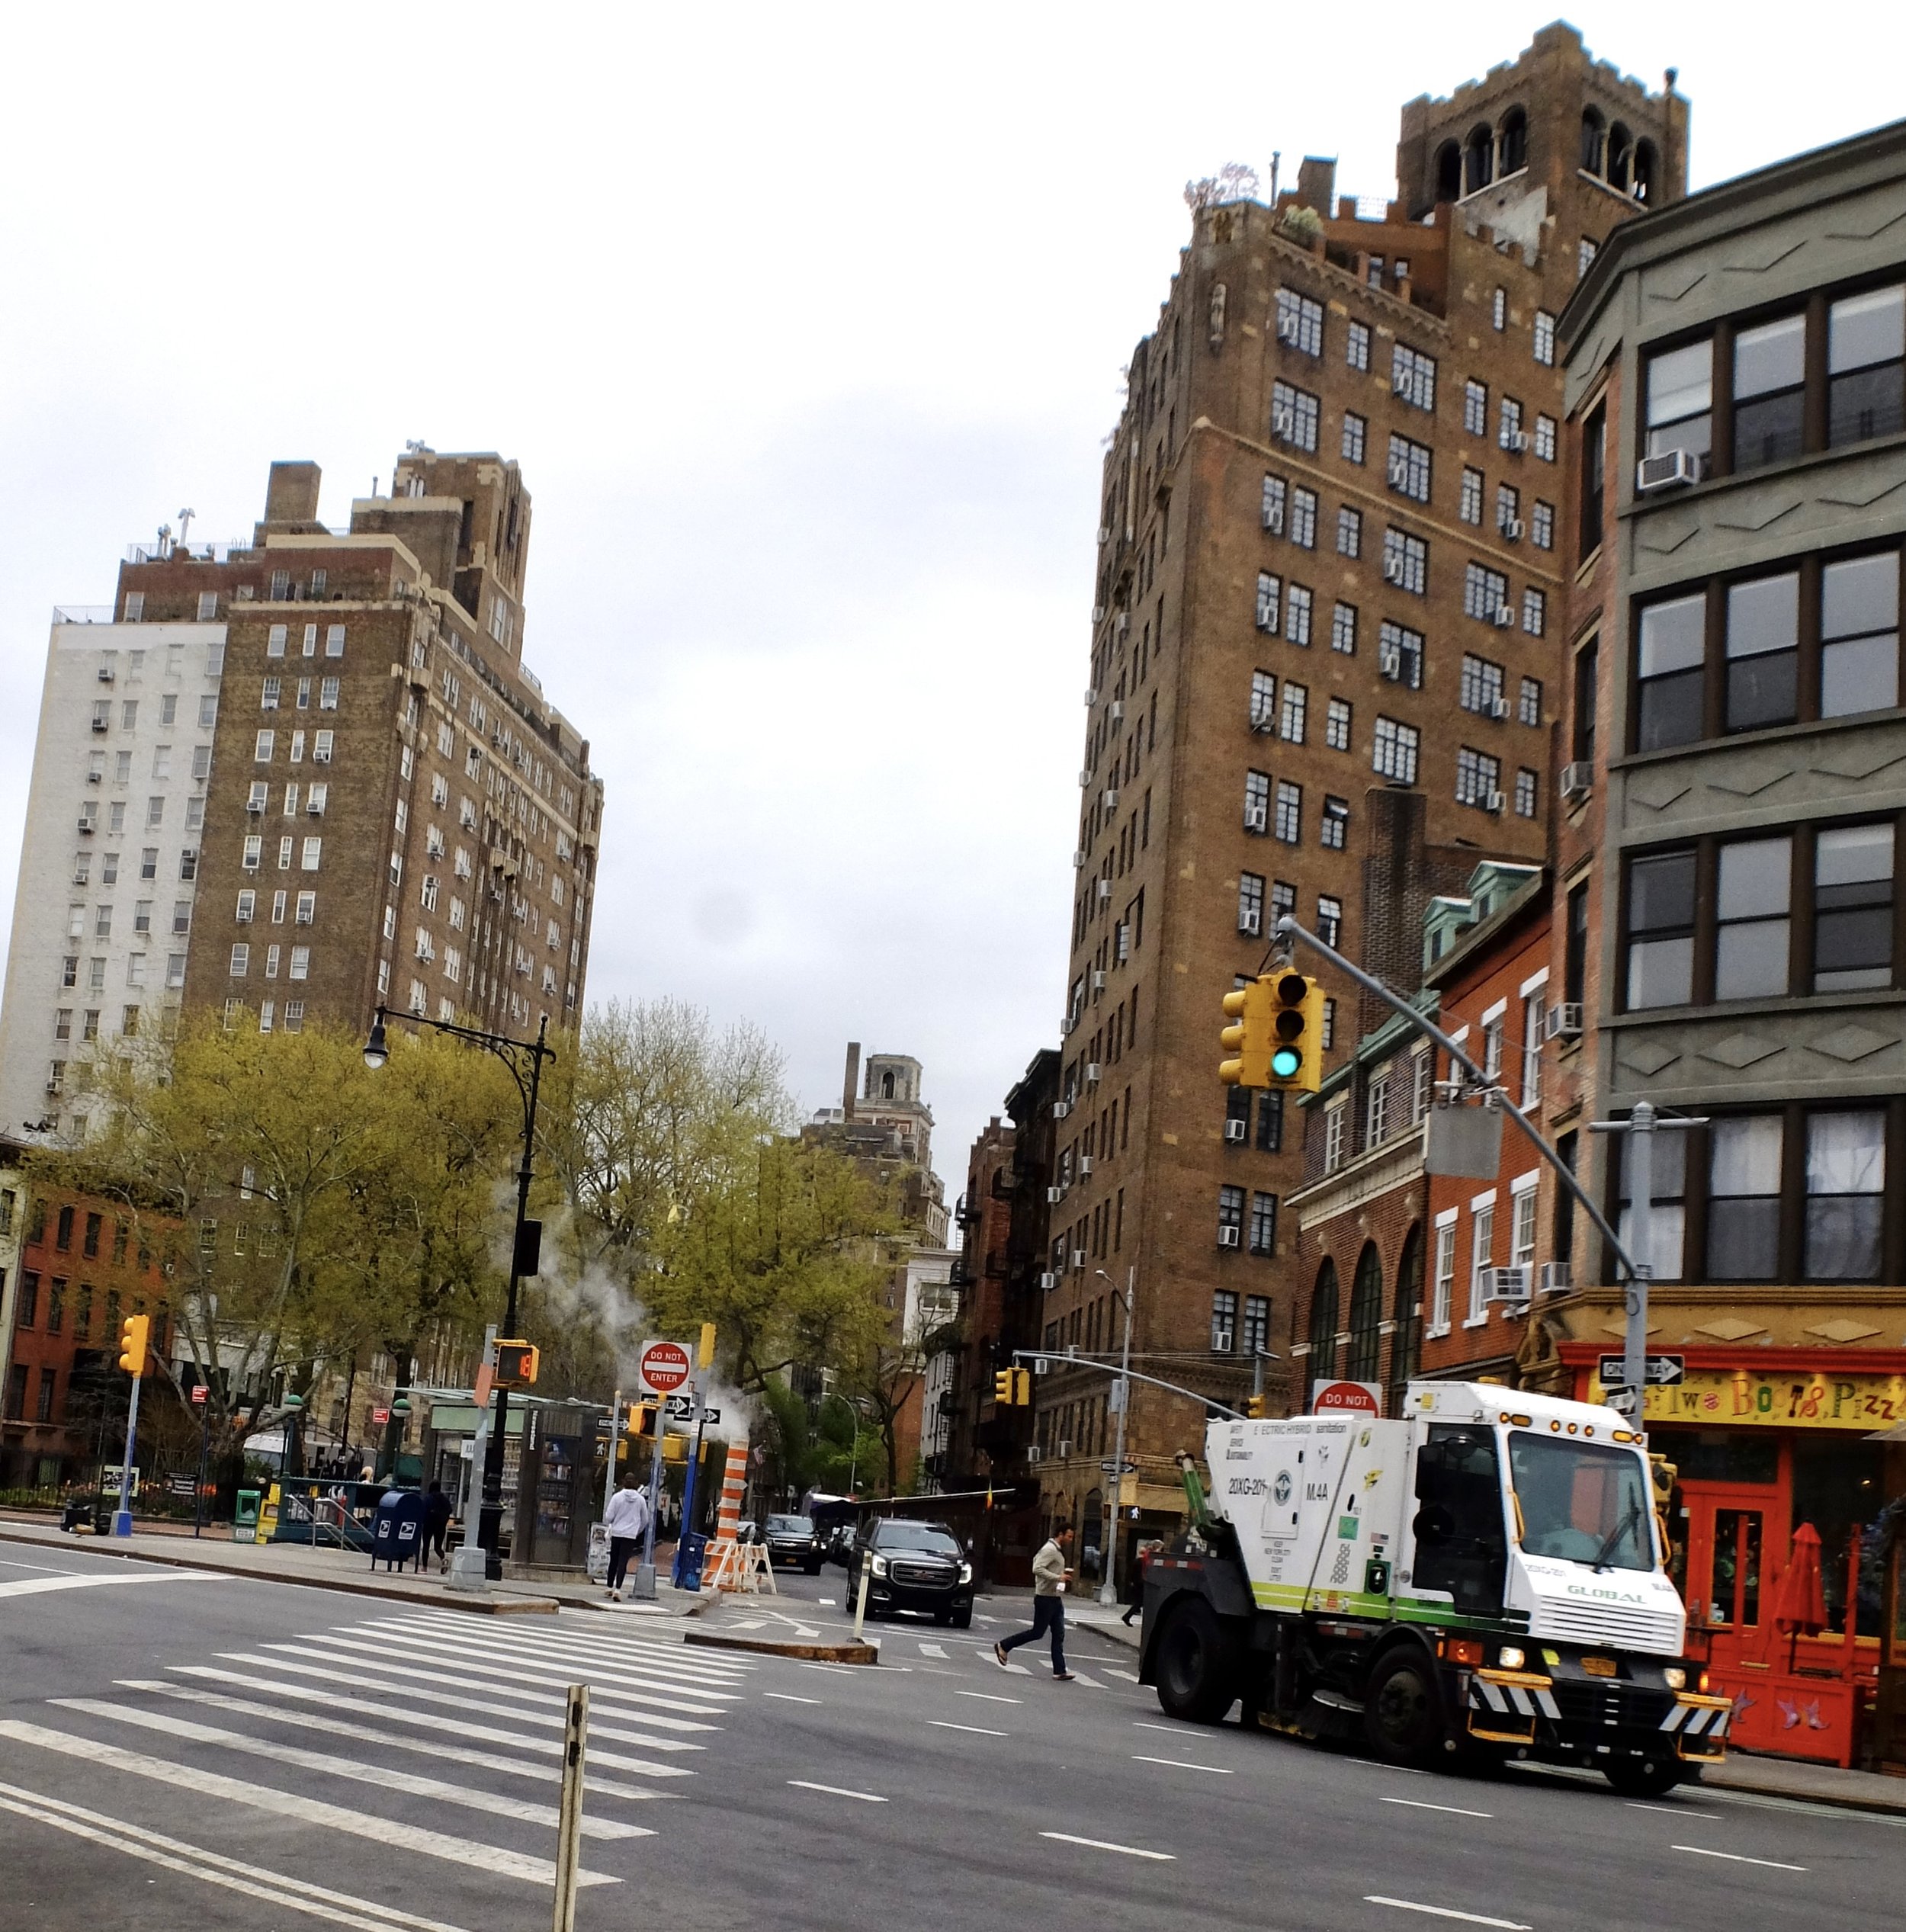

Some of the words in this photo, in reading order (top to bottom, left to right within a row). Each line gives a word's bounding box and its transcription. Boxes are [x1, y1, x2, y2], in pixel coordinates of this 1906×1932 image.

[665, 1353, 682, 1361] NOT
[650, 1373, 678, 1382] ENTER
[1327, 1394, 1342, 1404] DO
[1346, 1395, 1368, 1406] NOT
[668, 1401, 682, 1410] WAY
[1567, 1585, 1648, 1604] GLOBAL
